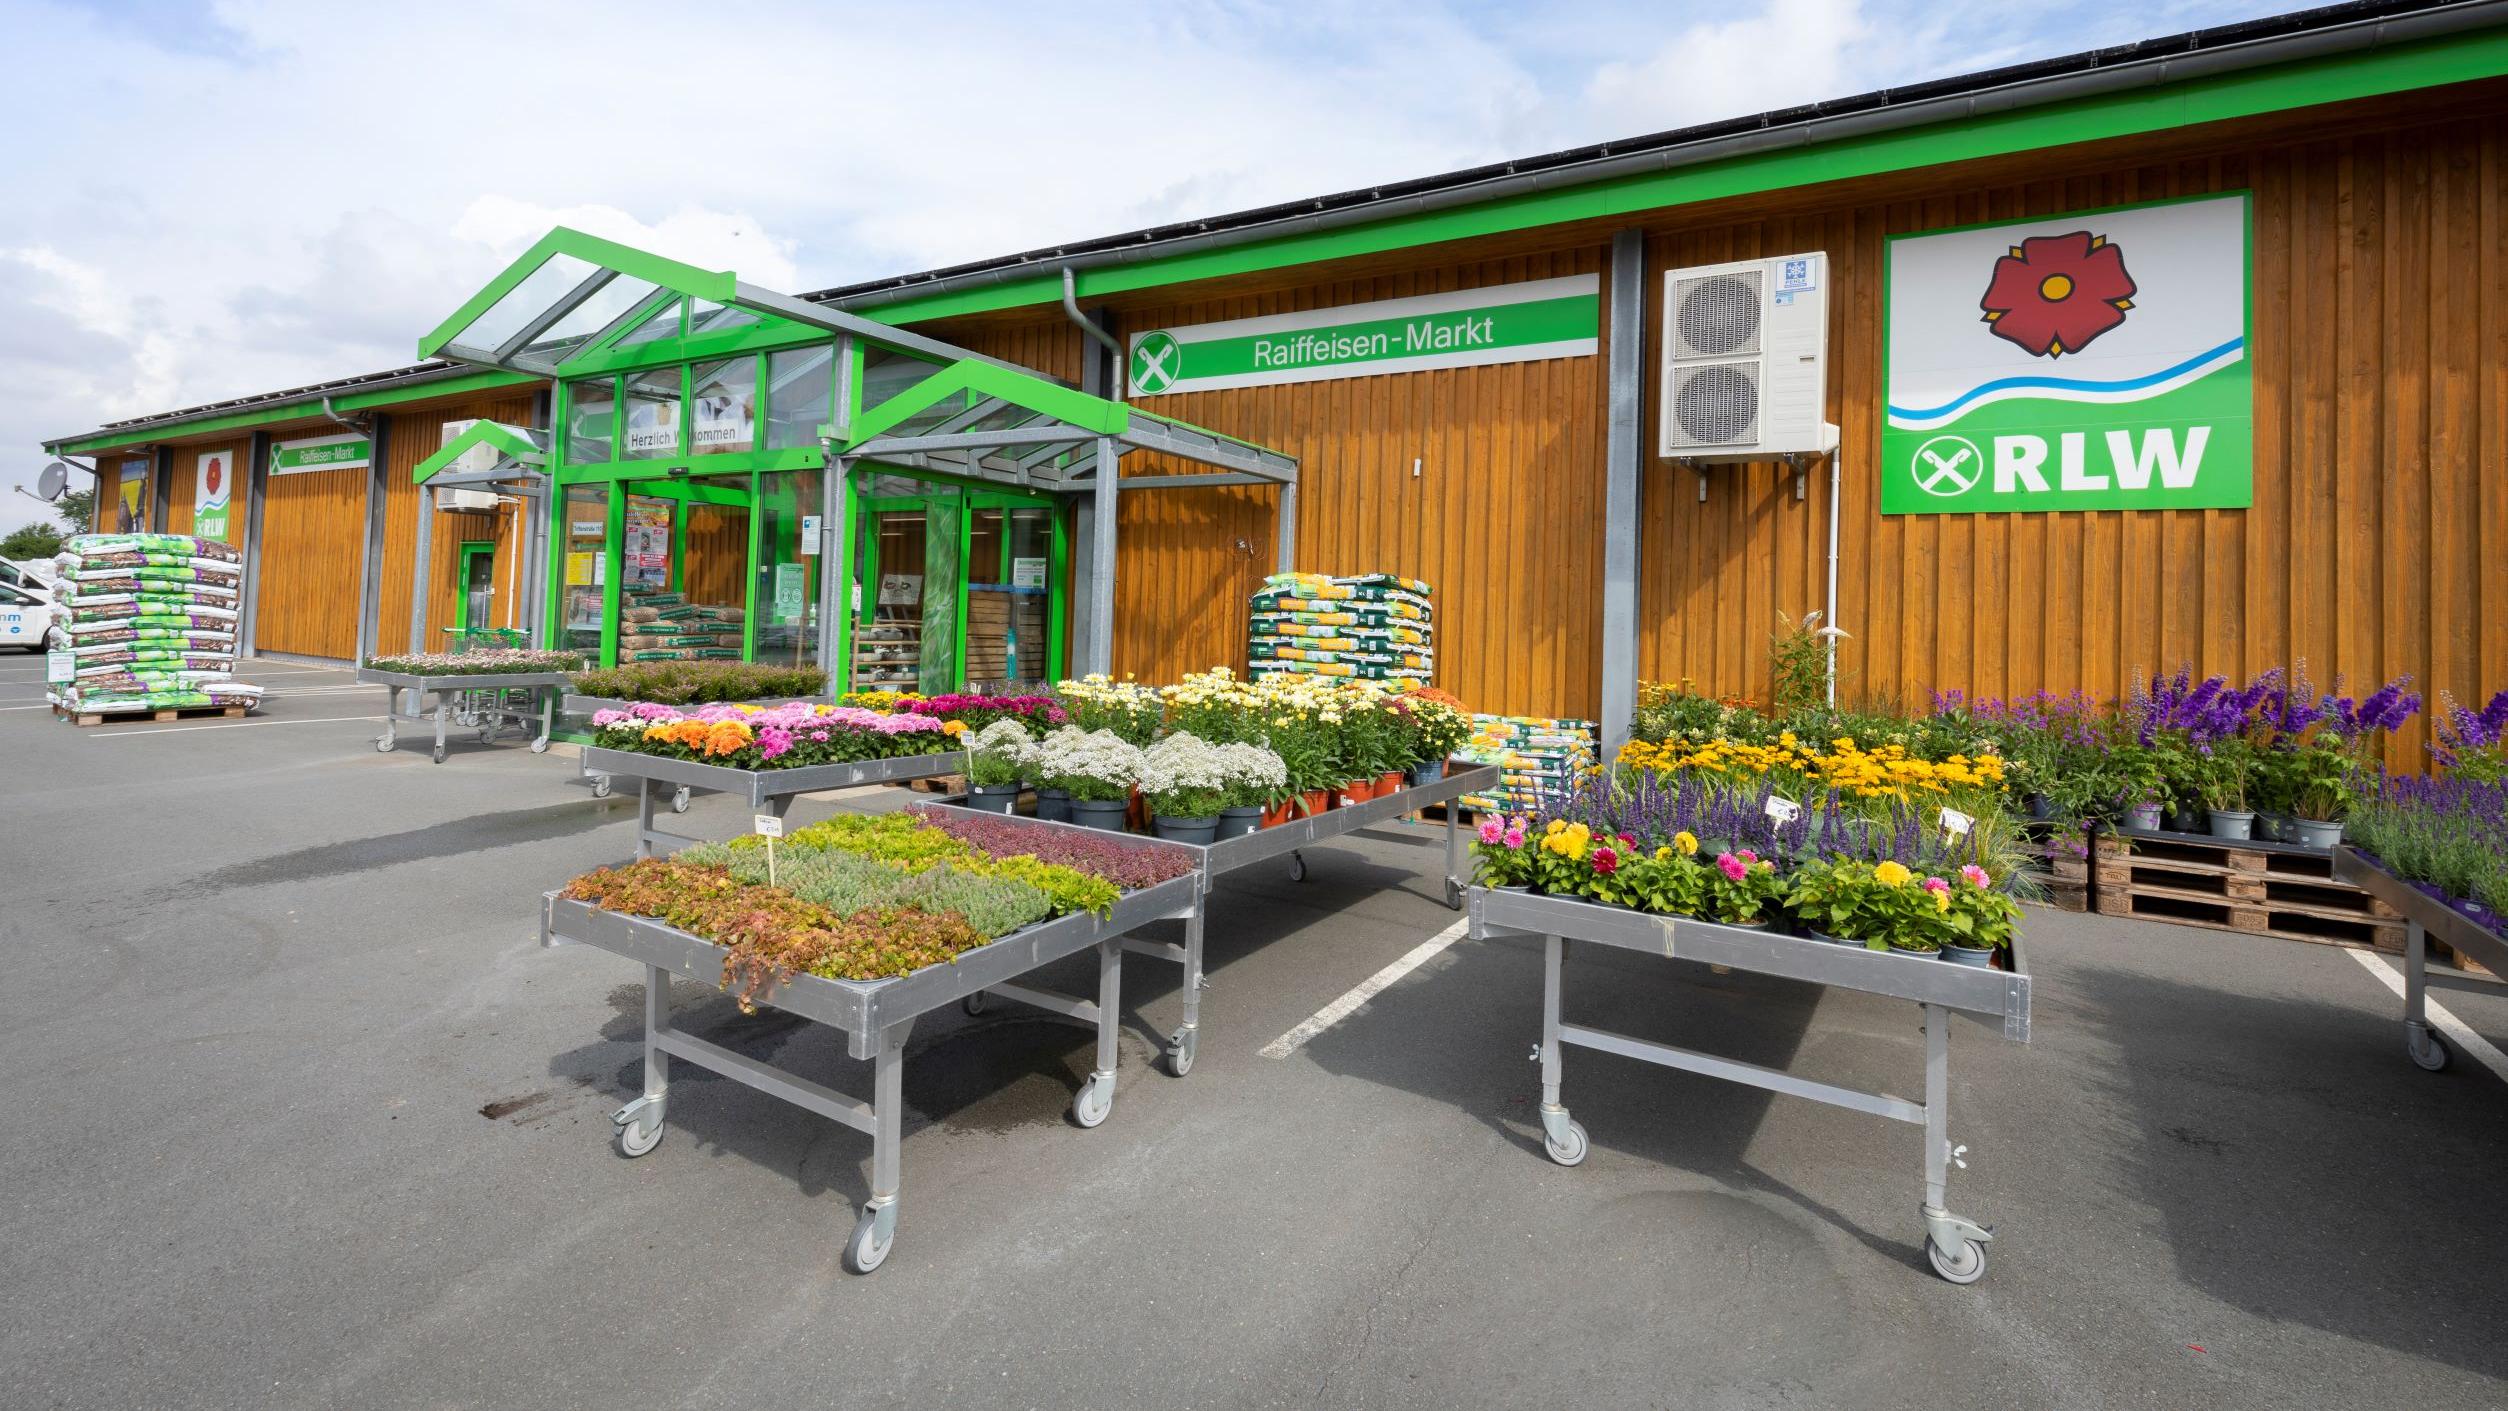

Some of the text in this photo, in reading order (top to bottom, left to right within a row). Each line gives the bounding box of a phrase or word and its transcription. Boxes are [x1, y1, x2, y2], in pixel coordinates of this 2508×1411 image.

[1254, 316, 1494, 368] Raiffeisen-Markt
[631, 430, 671, 447] Herzlich
[299, 446, 355, 464] Raiffeisen-Markt
[1993, 426, 2212, 493] RLW
[204, 517, 226, 537] RLW
